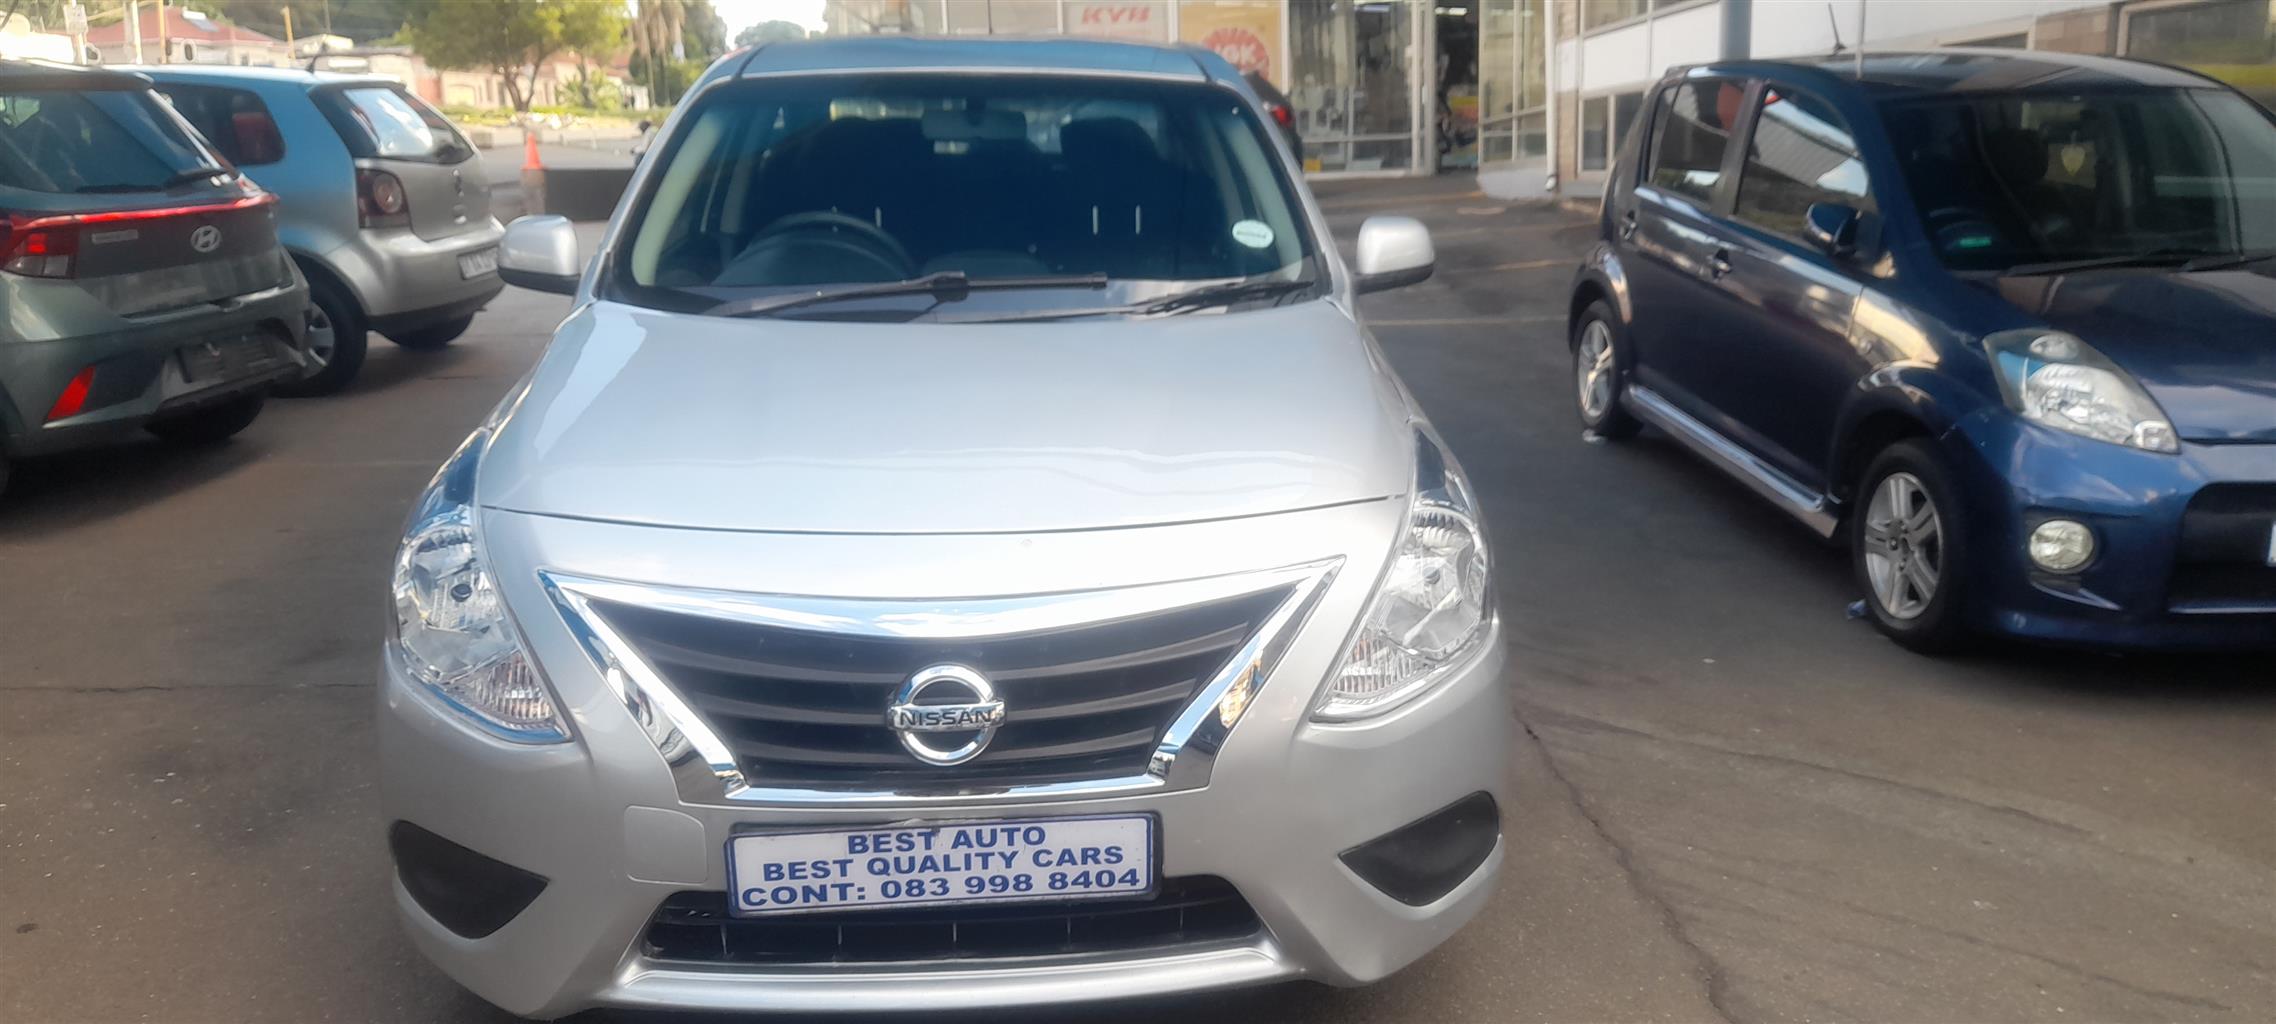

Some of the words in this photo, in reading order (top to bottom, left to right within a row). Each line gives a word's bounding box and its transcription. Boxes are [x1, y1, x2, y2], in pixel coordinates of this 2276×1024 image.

[900, 710, 991, 726] NISSAN
[847, 831, 934, 855] BEST
[950, 826, 1046, 850] AUTO
[763, 858, 854, 881] BEST
[866, 850, 1018, 877] QUALITY
[1032, 846, 1123, 868] CARS
[742, 882, 866, 906] CONT:
[880, 877, 950, 899] 083
[964, 873, 1033, 895] 998
[1048, 868, 1140, 890] 8404
